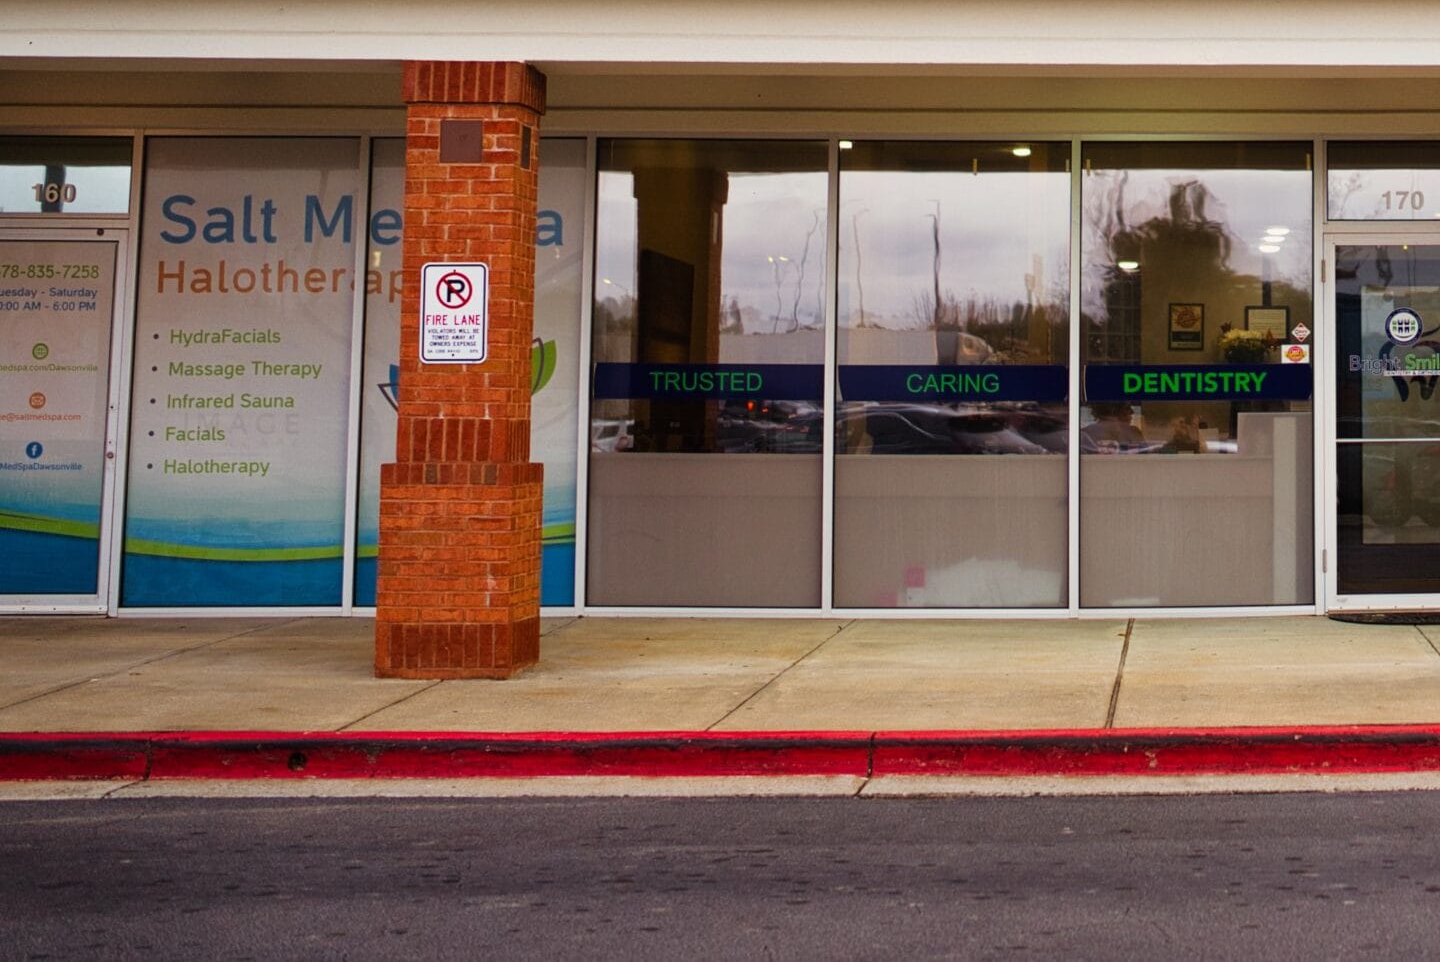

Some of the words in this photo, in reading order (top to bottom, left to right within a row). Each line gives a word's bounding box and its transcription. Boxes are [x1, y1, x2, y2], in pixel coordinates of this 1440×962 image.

[32, 183, 77, 204] 160
[1382, 190, 1425, 210] 170
[160, 194, 278, 244] Salt
[304, 194, 404, 246] Me
[0, 264, 100, 279] 78-835-7258
[157, 259, 403, 303] Halotherap
[49, 287, 98, 299] Saturday
[23, 301, 41, 311] AM
[52, 301, 76, 311] 6:00
[78, 301, 96, 311] PM
[425, 314, 448, 326] FIRE
[454, 314, 480, 326] LANE
[169, 328, 281, 347] HydraFacials
[168, 361, 245, 380] Massage
[252, 360, 322, 379] Therapy
[1349, 353, 1402, 375] Bright
[649, 371, 763, 392] TRUSTED
[906, 373, 1000, 393] CARING
[1123, 371, 1268, 394] DENTISTRY
[167, 393, 234, 409] Infrared
[240, 393, 295, 409] Sauna
[165, 426, 226, 442] Facials
[164, 458, 270, 476] Halotherapy
